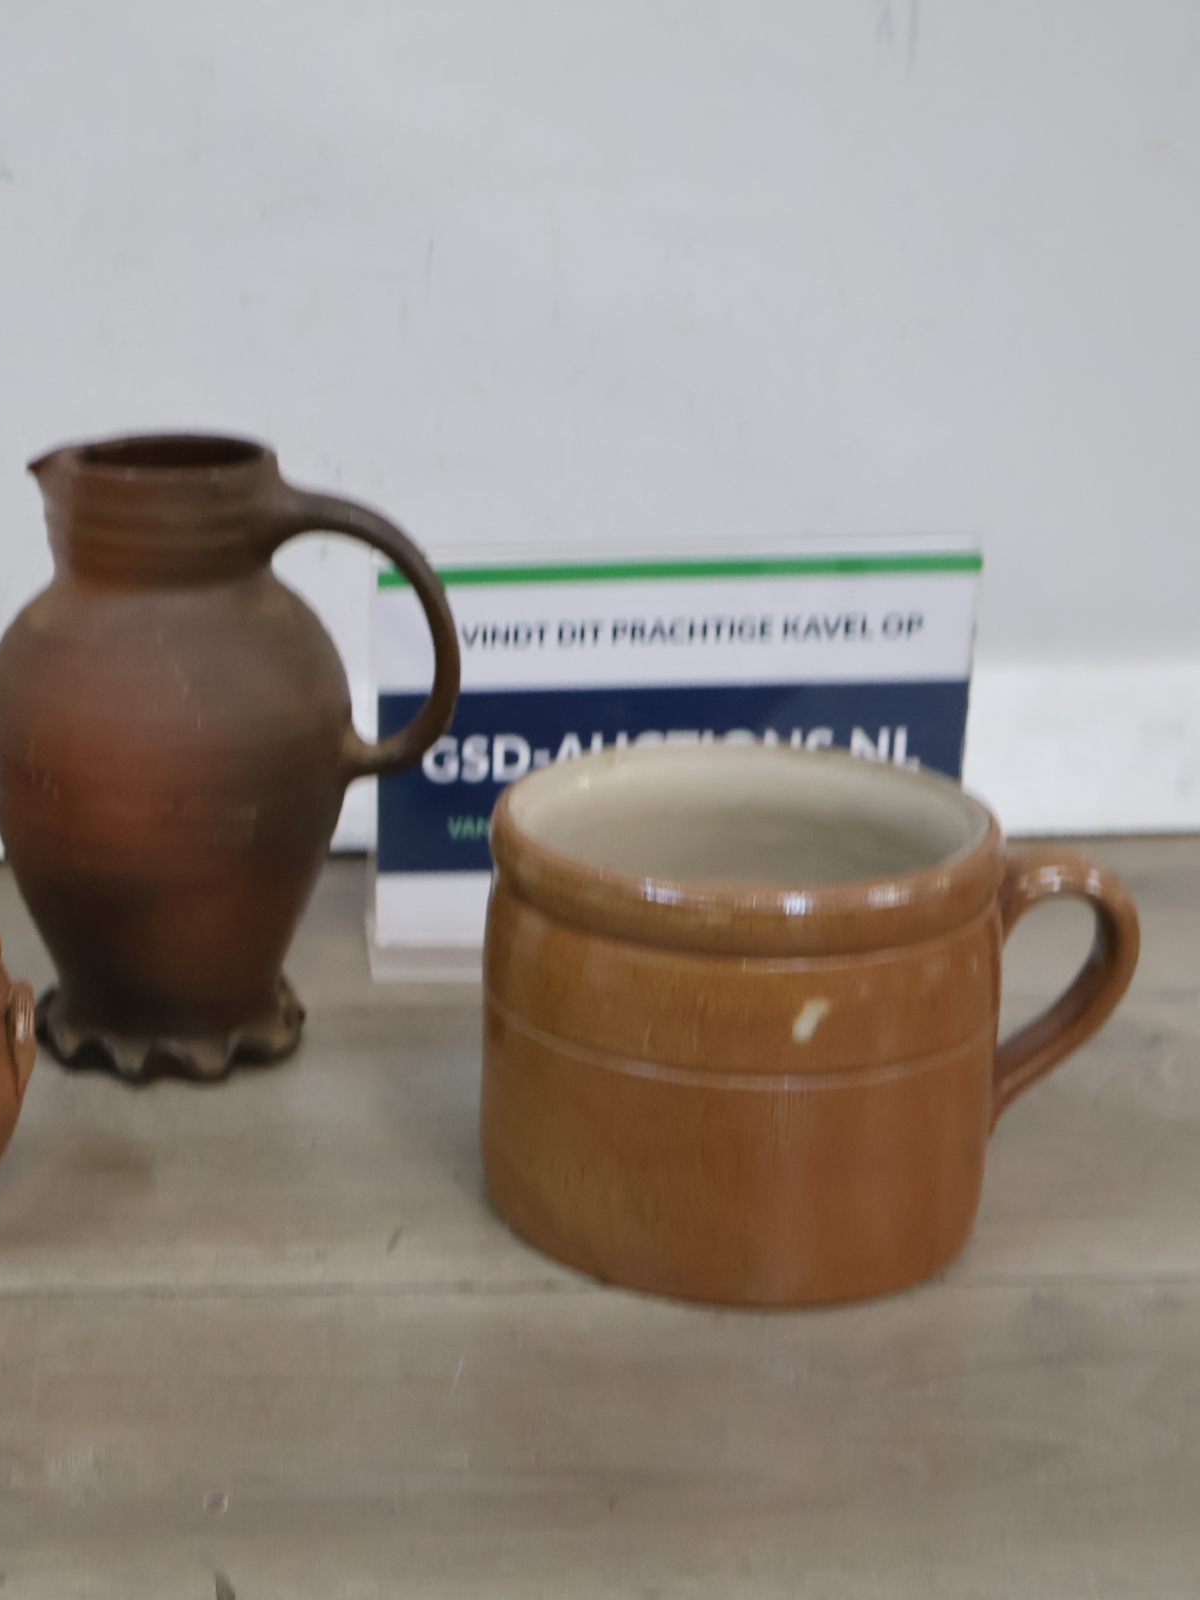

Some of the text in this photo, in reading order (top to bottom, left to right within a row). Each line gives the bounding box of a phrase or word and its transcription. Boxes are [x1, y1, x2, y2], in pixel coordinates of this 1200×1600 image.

[461, 611, 924, 649] VINDT DIT PRACHTIGE KAVEL OP
